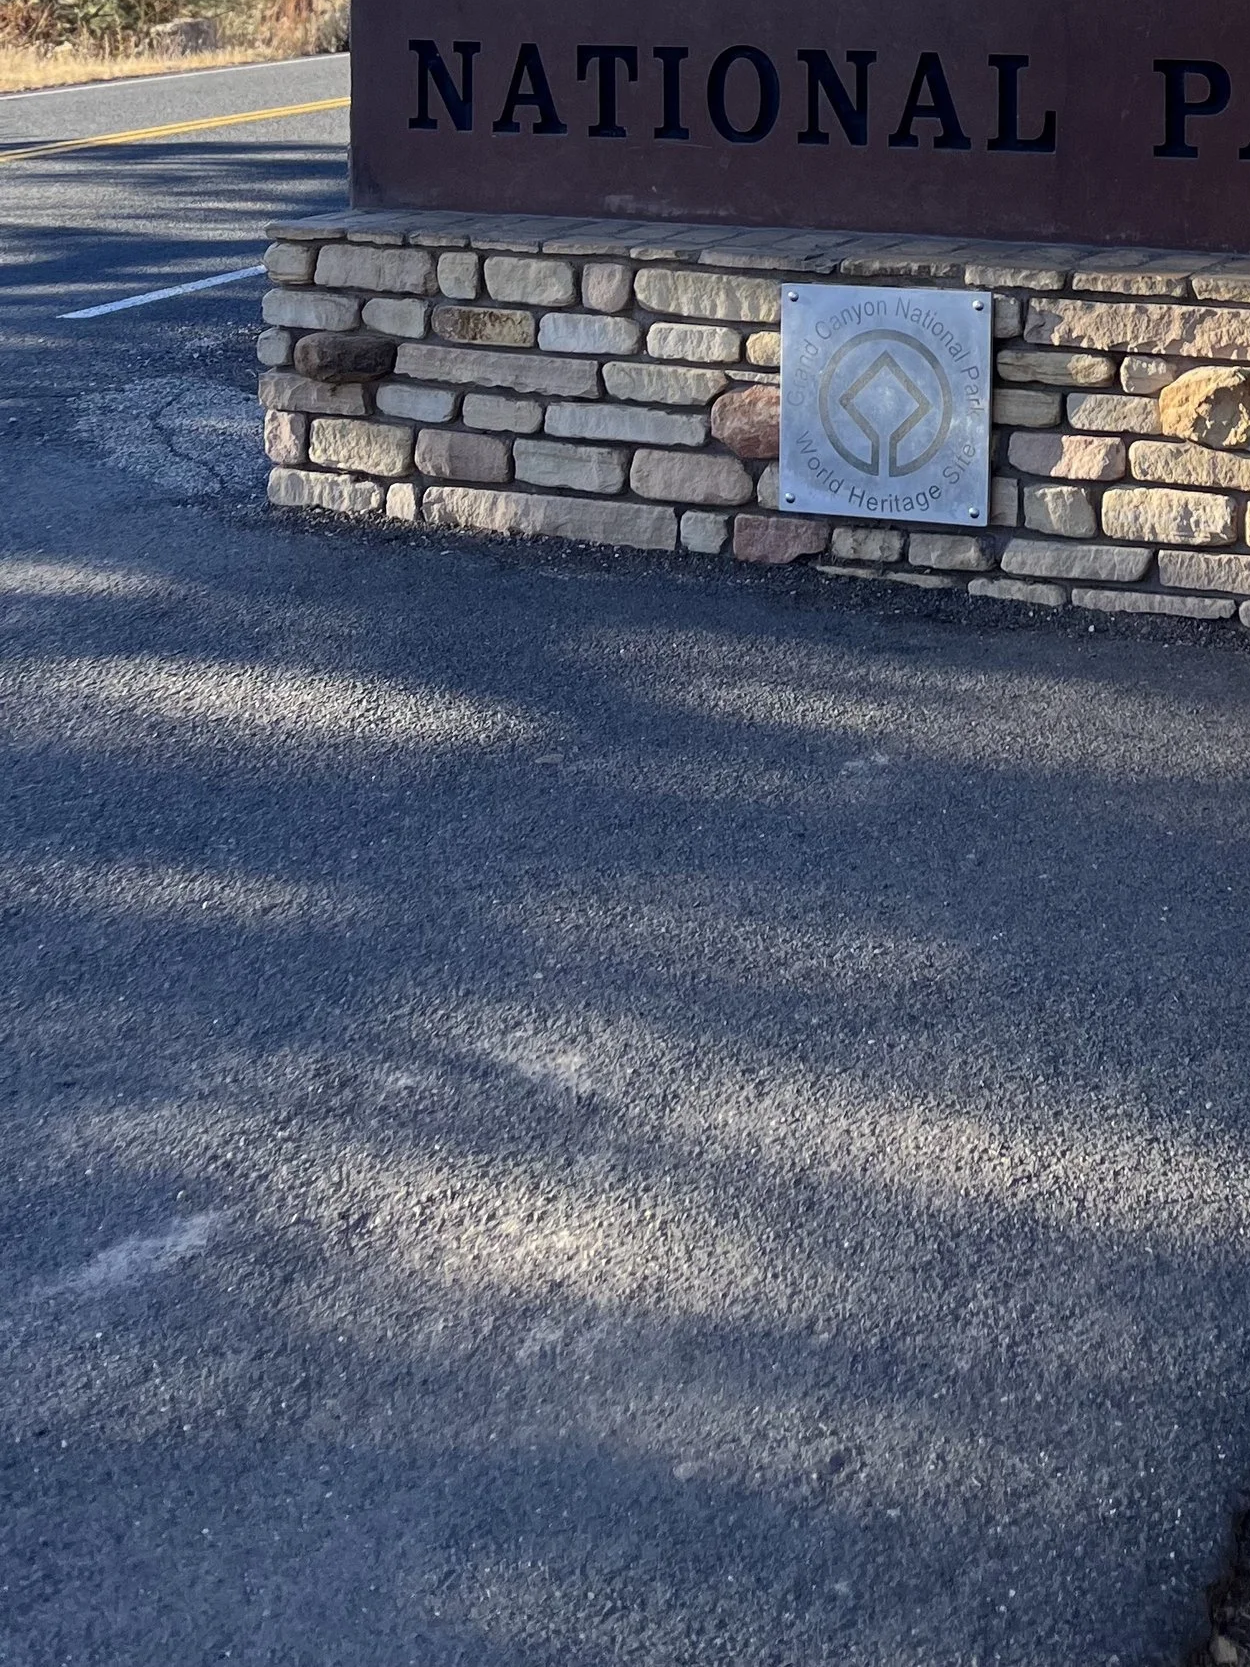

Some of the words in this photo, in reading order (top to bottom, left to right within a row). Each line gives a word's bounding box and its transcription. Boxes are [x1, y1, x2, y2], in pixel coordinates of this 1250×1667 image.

[408, 39, 1057, 154] NATIONAL
[786, 338, 819, 408] Grand
[814, 298, 887, 341] Canyon
[895, 297, 970, 363] National
[960, 364, 985, 420] Park
[795, 430, 845, 494] World
[847, 484, 943, 513] Heritage
[942, 442, 977, 485] Site
